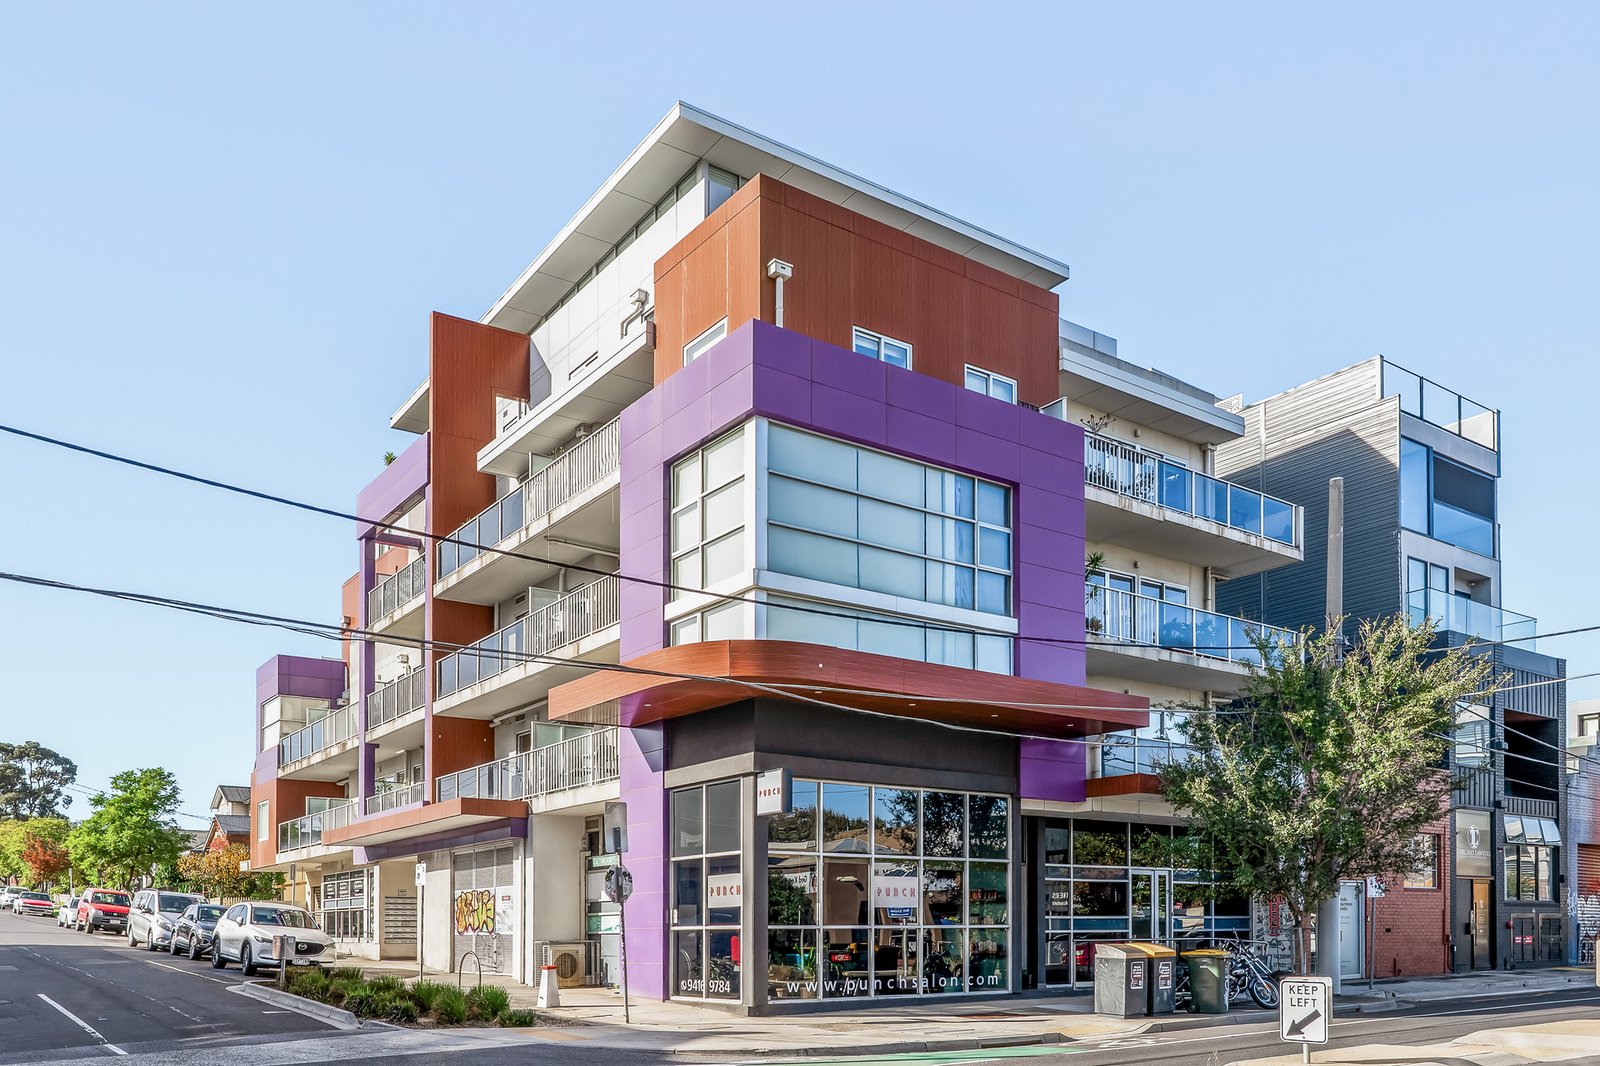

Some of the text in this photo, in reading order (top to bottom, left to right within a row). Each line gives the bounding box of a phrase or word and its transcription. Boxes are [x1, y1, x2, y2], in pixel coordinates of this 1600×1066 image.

[759, 787, 781, 797] PUNCH
[710, 885, 741, 896] PUNCH
[876, 886, 916, 898] PUNCH
[687, 979, 731, 993] 9416 9784
[1288, 985, 1319, 995] KEEP
[1290, 997, 1318, 1008] LEFT
